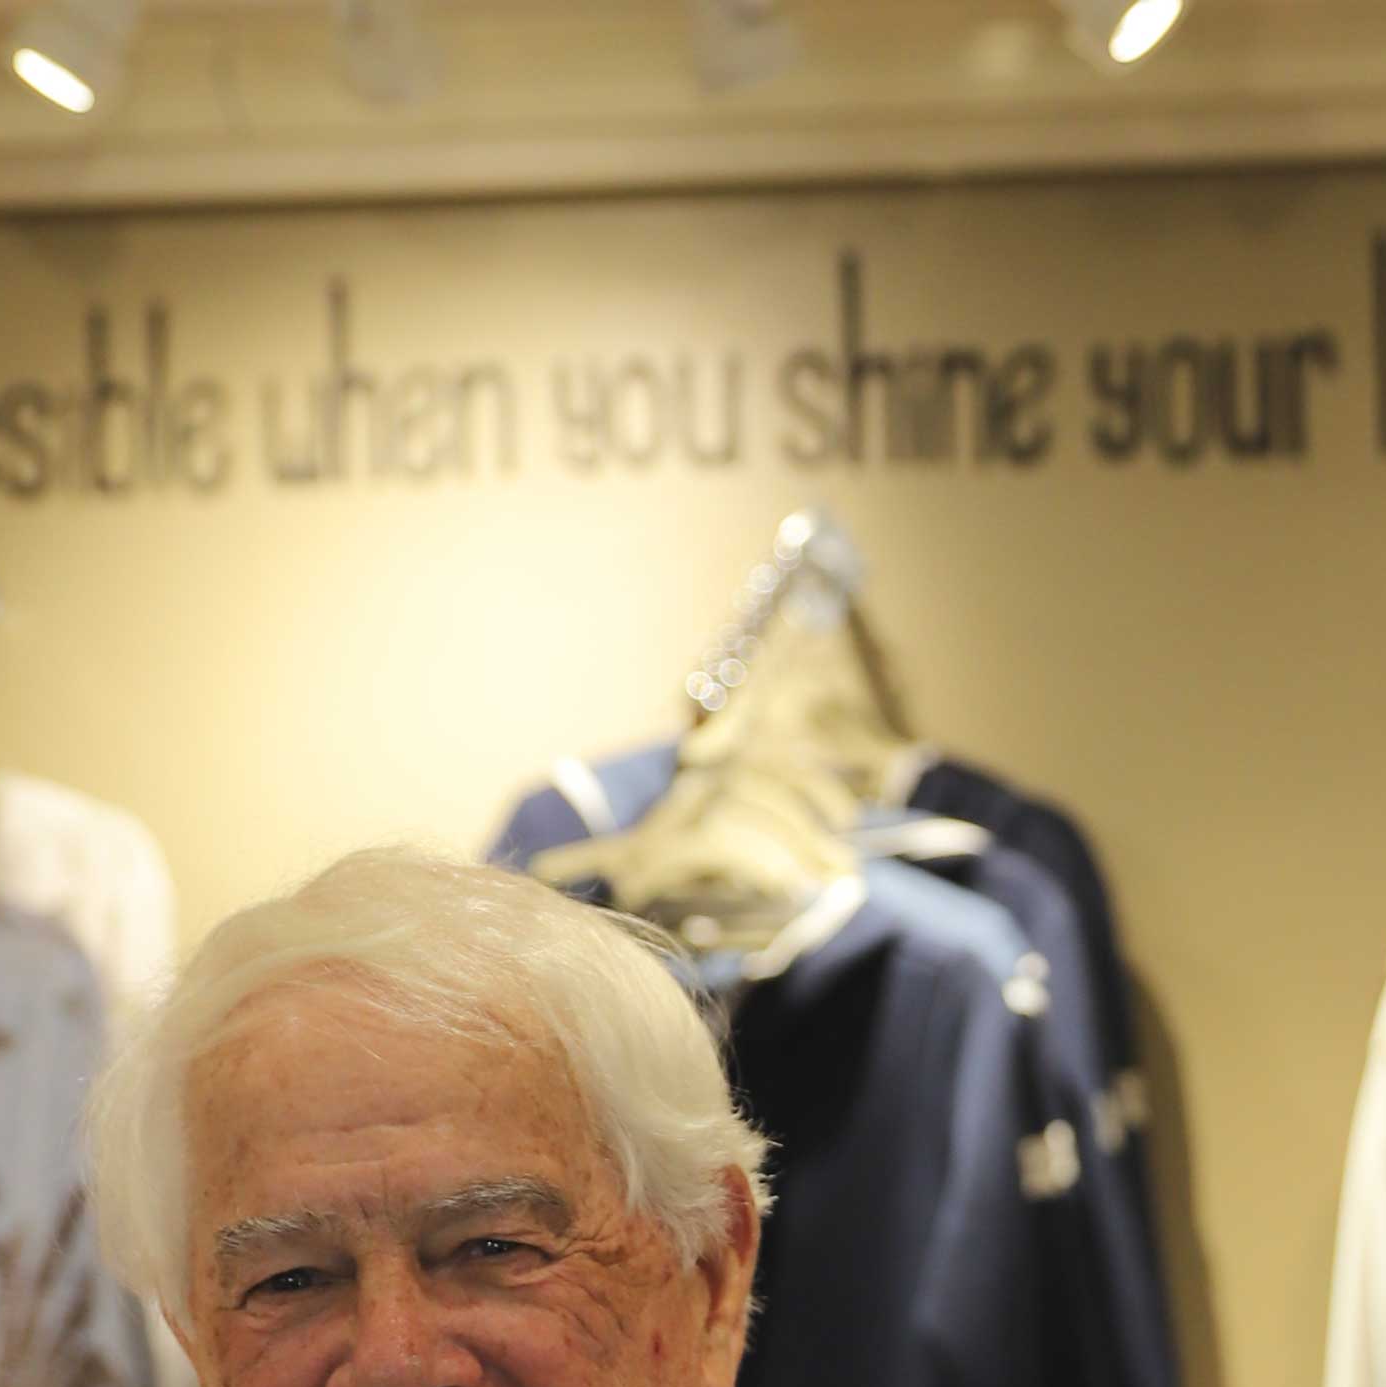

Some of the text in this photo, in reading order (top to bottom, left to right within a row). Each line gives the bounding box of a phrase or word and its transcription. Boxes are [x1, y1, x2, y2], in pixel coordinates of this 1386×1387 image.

[261, 274, 521, 485] when
[548, 348, 743, 471] you
[775, 250, 1057, 470] shine
[1087, 326, 1340, 466] your
